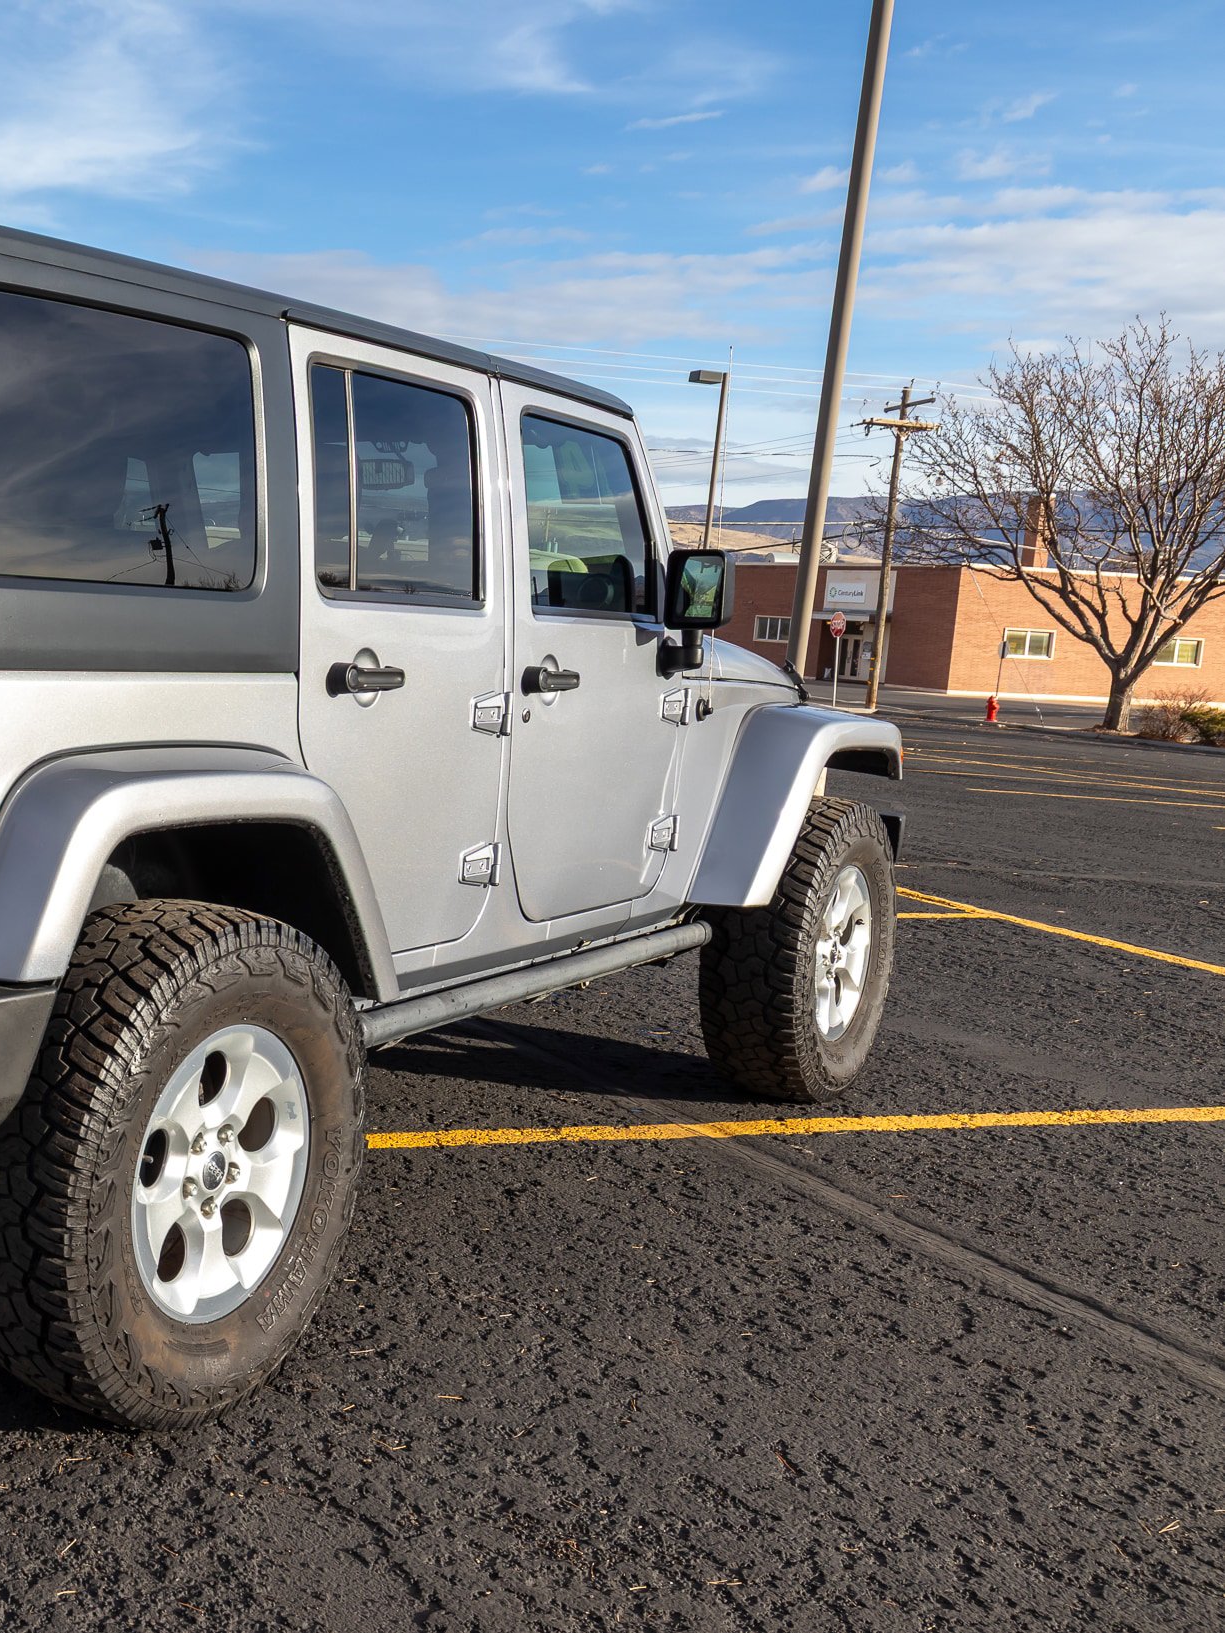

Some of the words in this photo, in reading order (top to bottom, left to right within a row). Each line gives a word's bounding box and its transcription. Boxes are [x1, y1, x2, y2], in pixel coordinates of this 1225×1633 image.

[837, 589, 864, 597] CenturyLink
[831, 620, 845, 630] STOP
[255, 1124, 344, 1334] YOKOHAMA
